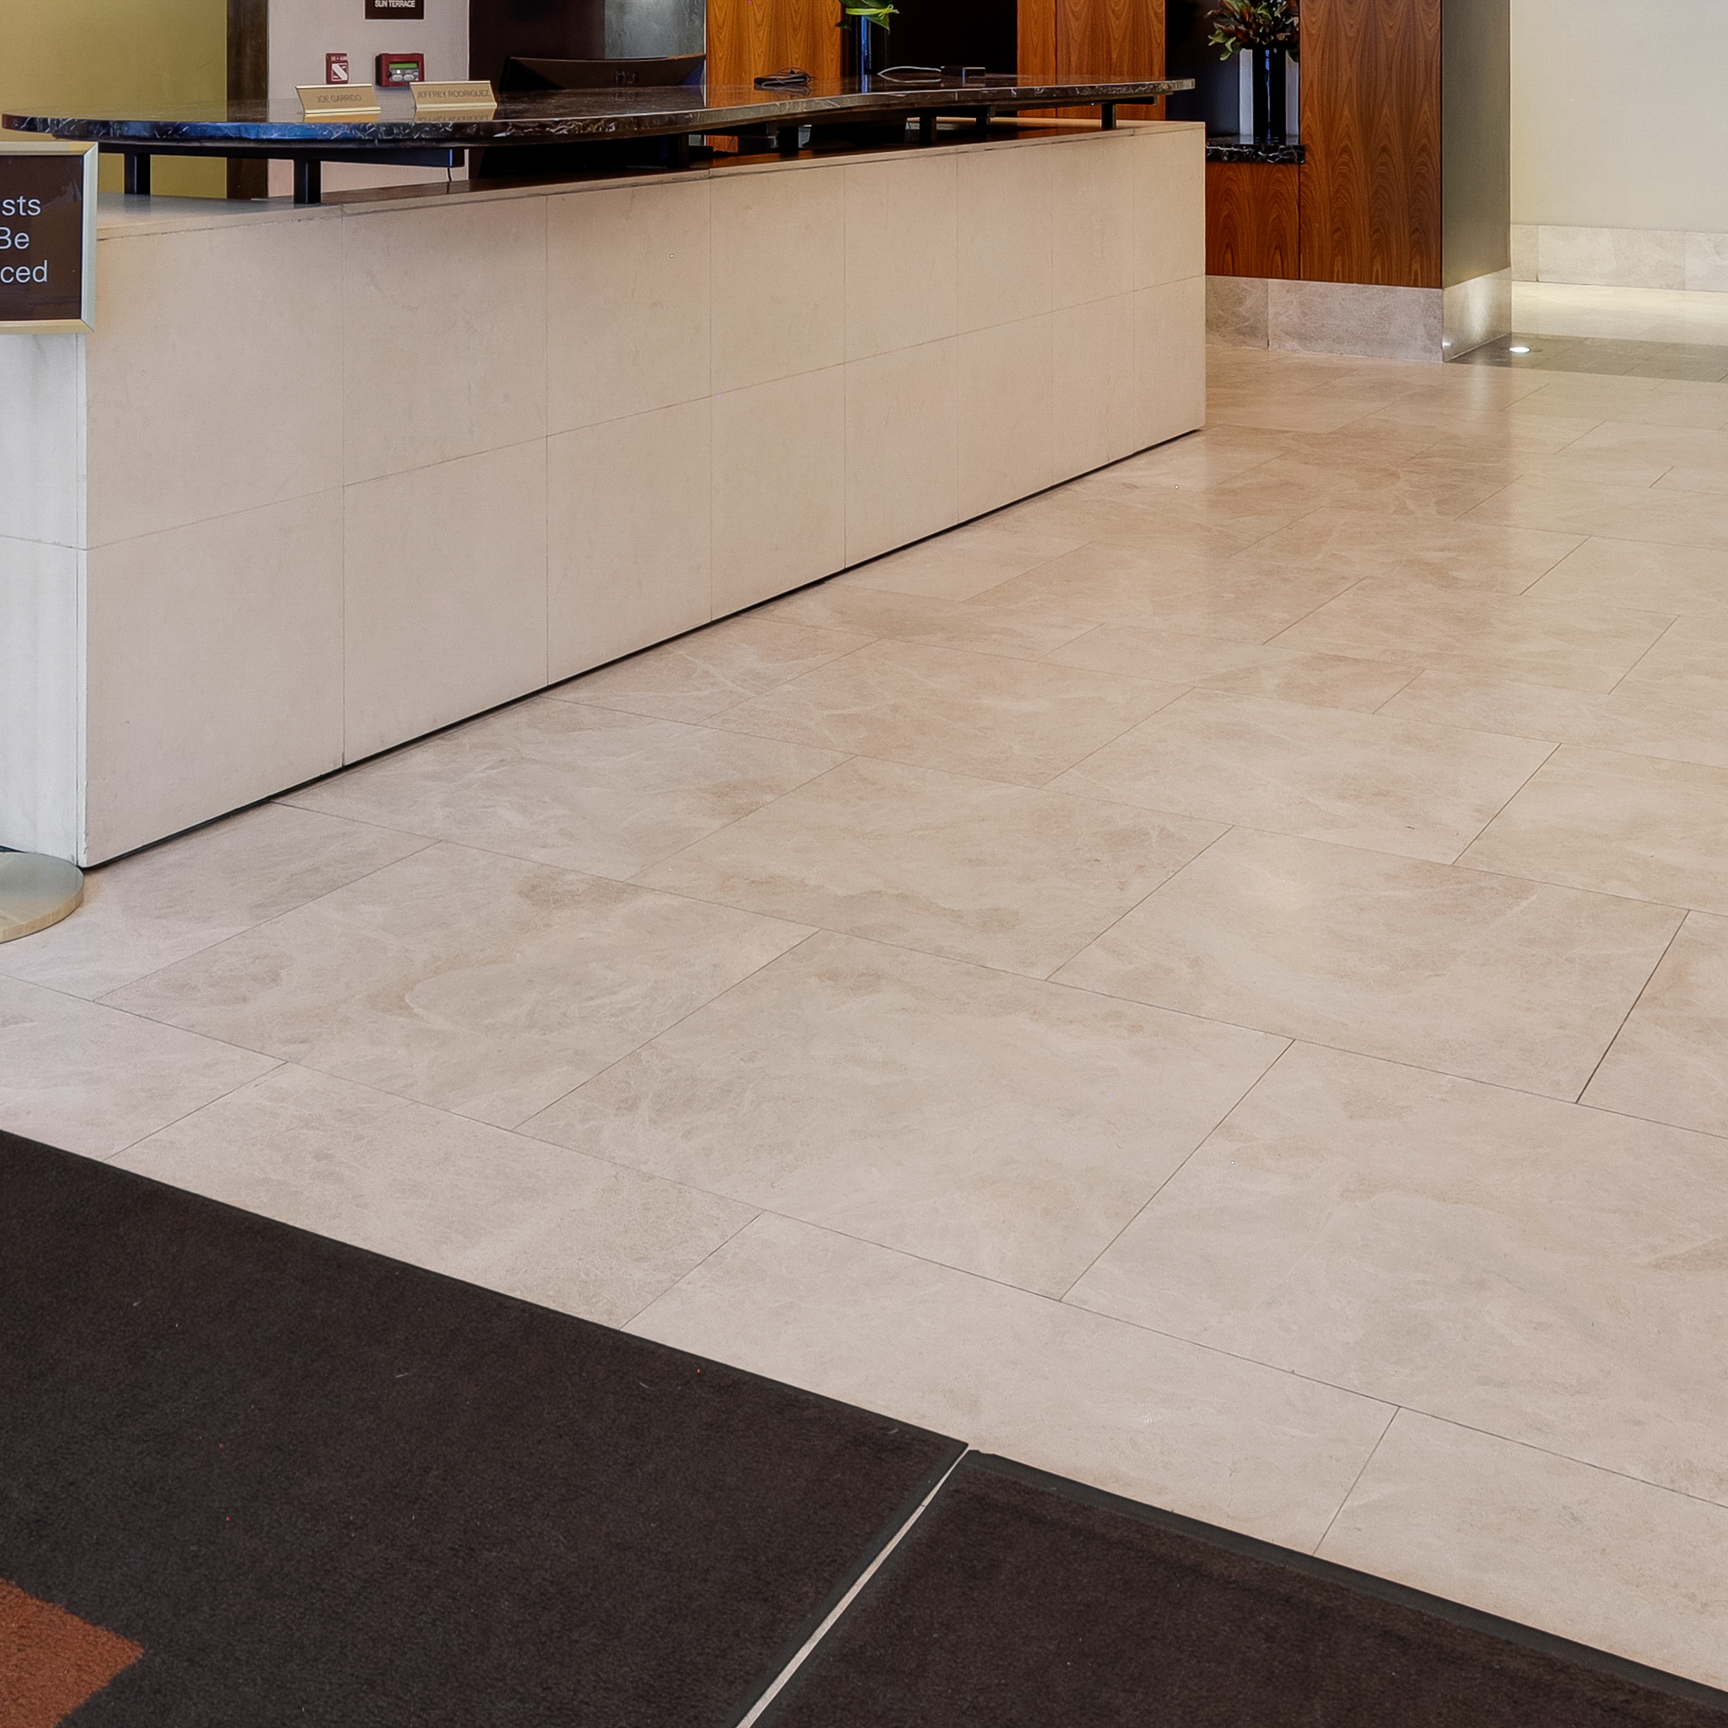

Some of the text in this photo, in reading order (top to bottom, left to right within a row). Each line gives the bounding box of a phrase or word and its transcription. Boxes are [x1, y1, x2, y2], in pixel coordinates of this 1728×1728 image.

[374, 0, 416, 8] SUN TERRACE
[417, 88, 491, 99] JEFFREY RODRIGUEZ
[316, 95, 330, 103] JOE
